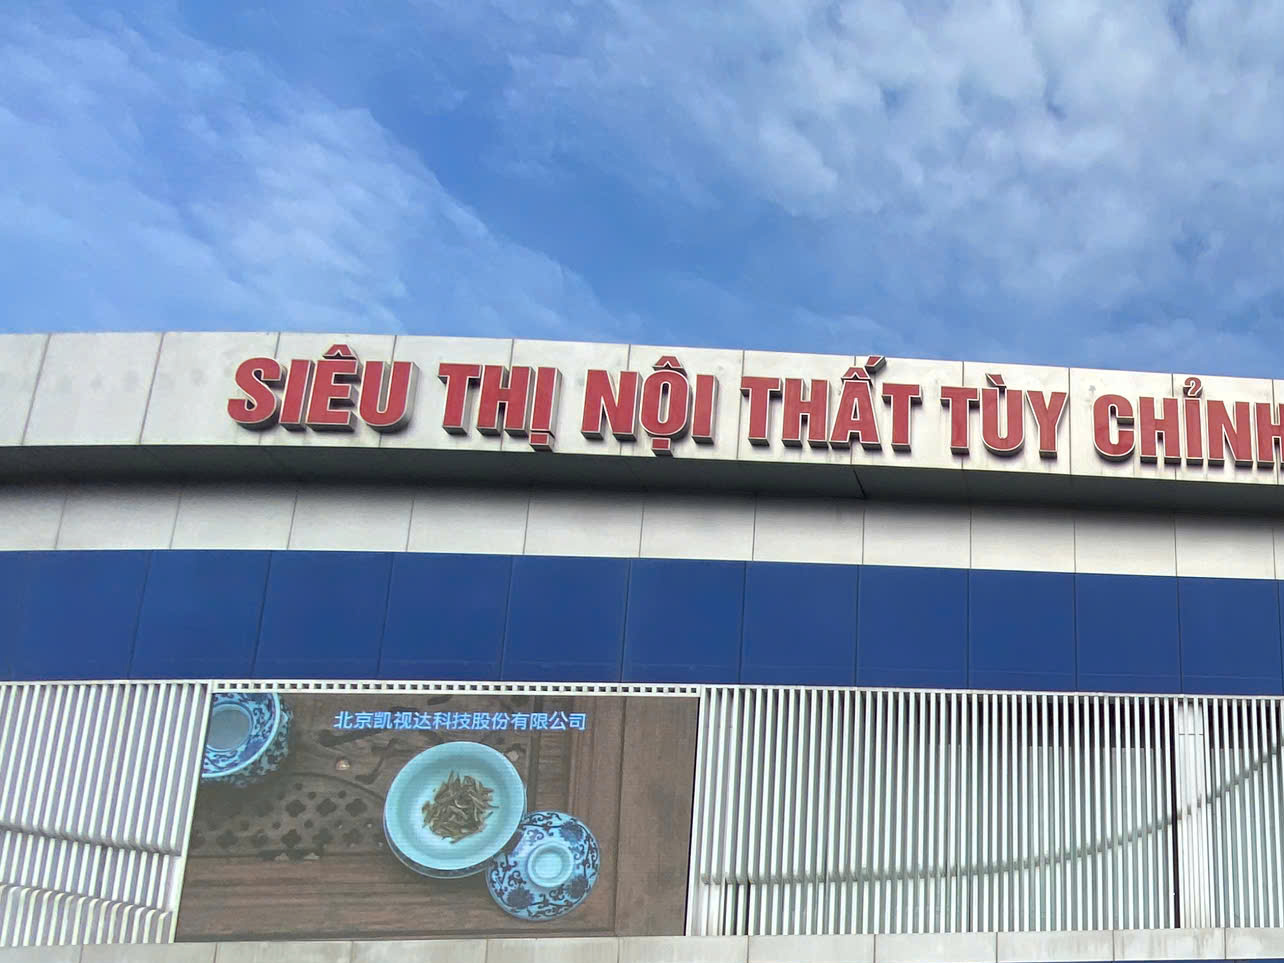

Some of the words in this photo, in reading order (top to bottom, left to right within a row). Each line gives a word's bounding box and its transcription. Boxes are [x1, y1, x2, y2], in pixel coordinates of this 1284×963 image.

[227, 344, 417, 432] SIÊU
[438, 363, 562, 451] THỊ
[581, 356, 718, 456] NỘI
[740, 355, 921, 451] THẤT
[941, 374, 1067, 459] TÙY
[333, 711, 587, 731] 北京凯视达科技股份有限公司
